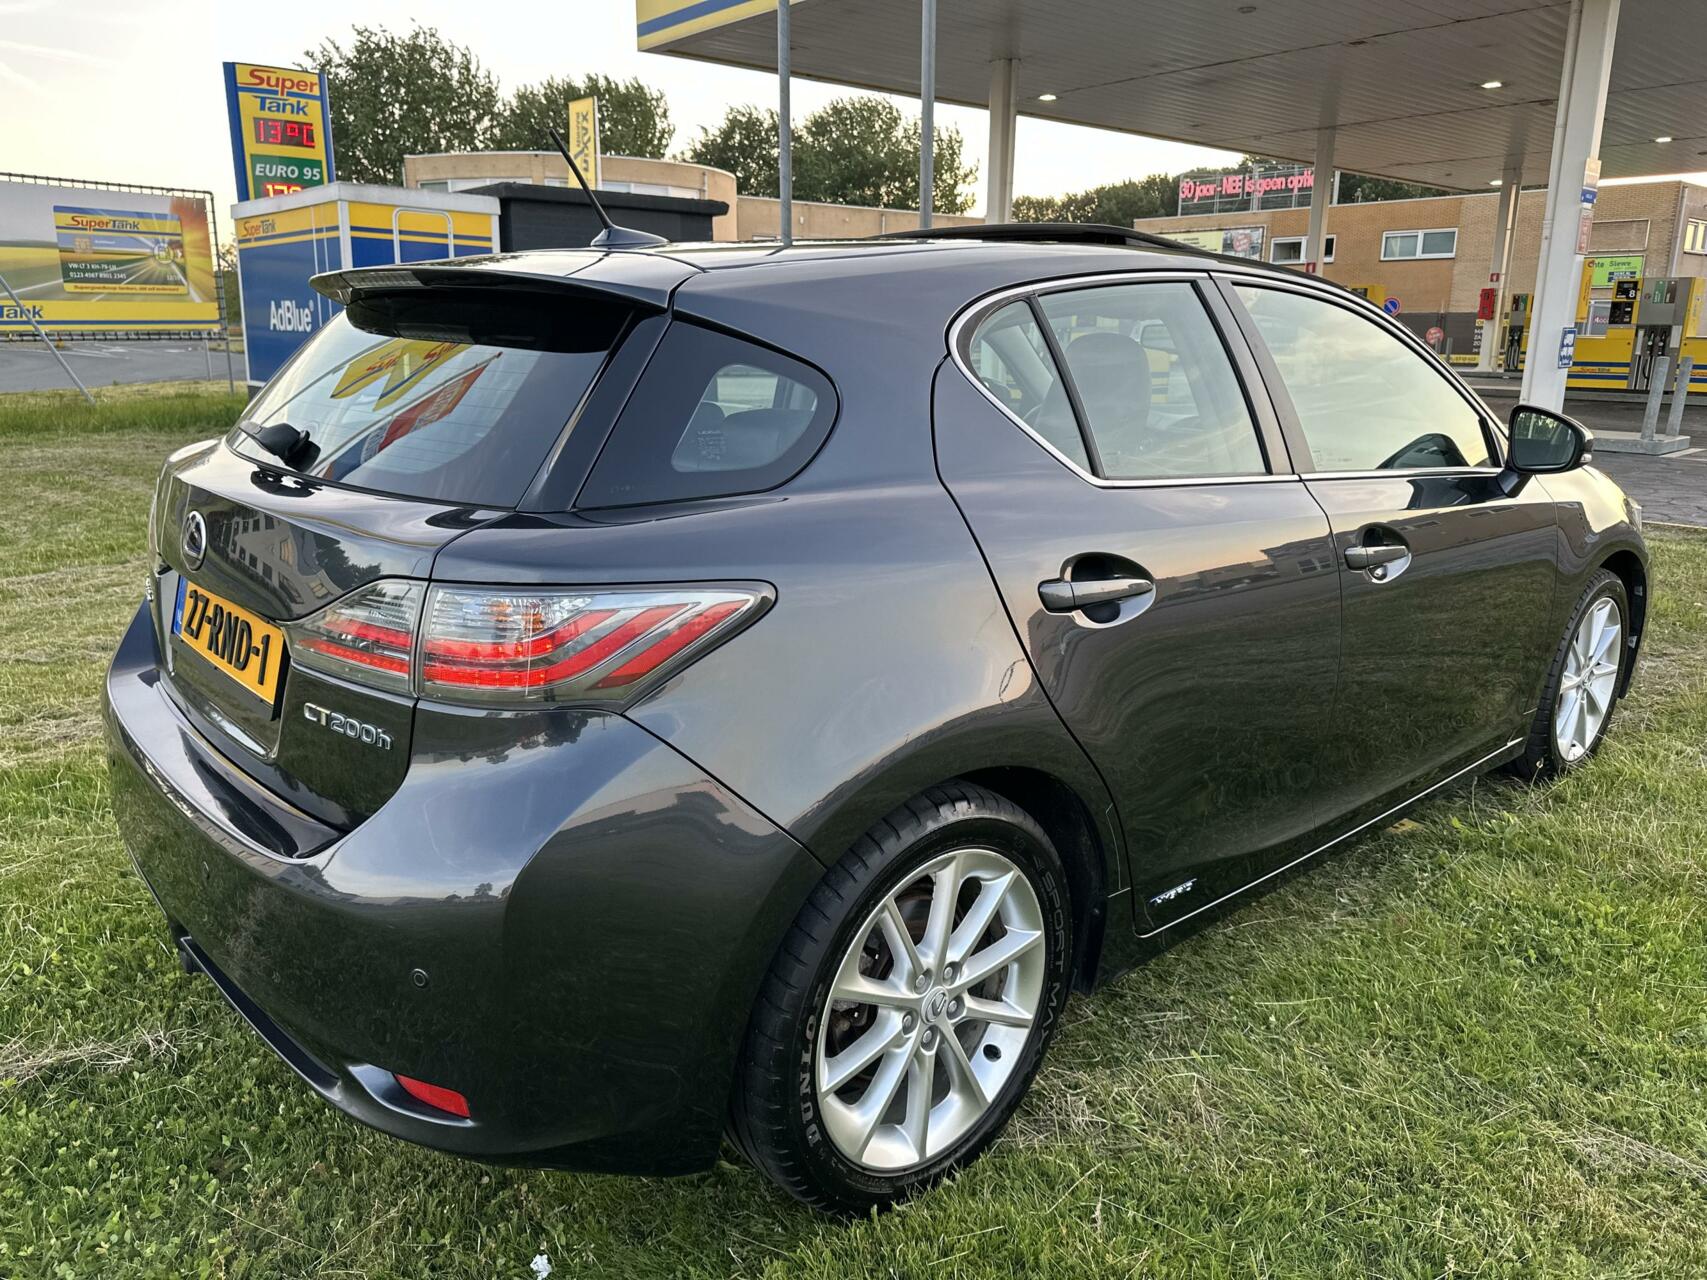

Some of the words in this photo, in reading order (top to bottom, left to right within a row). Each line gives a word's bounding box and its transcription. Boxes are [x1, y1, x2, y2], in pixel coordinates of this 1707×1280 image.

[237, 68, 318, 97] Super
[252, 95, 308, 116] Tank
[255, 163, 299, 179] EURO
[303, 167, 321, 181] 95
[1255, 176, 1285, 197] geen
[1629, 290, 1636, 298] 8
[184, 589, 271, 686] 27-RND-1
[1041, 871, 1064, 974] SPORT
